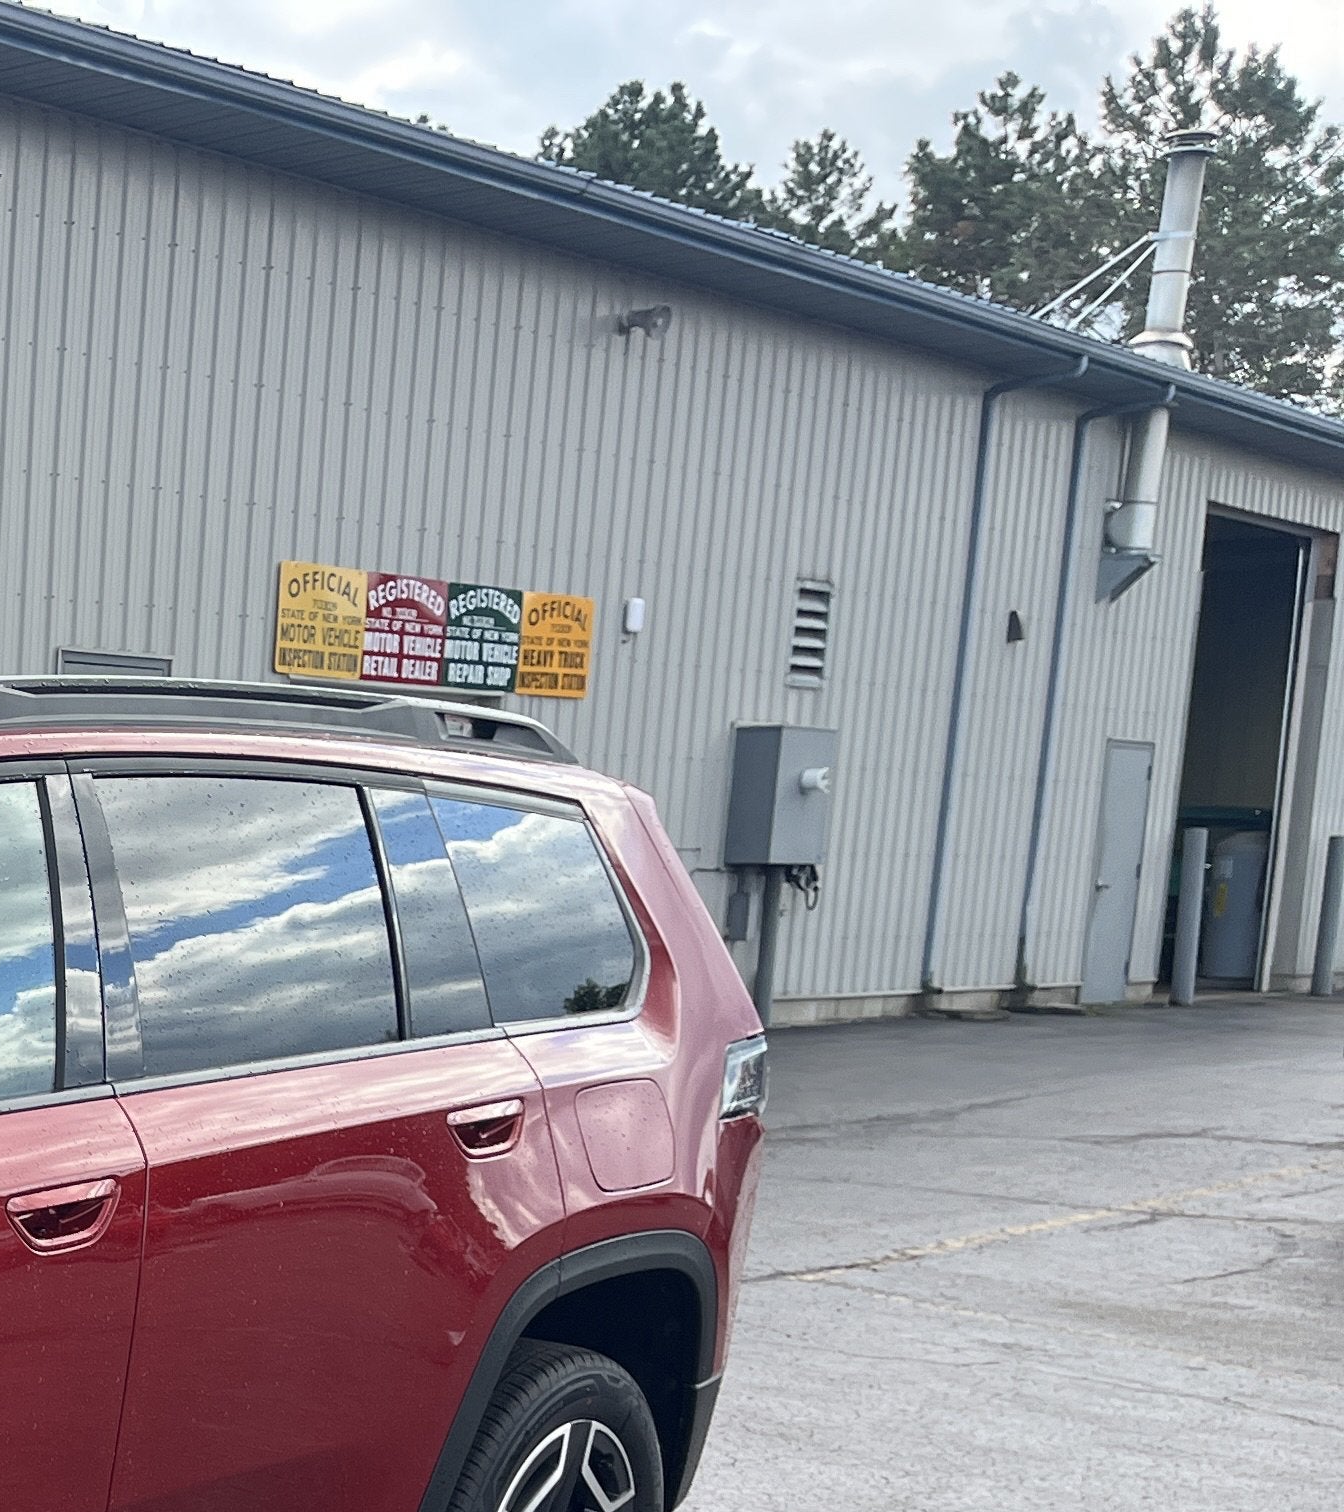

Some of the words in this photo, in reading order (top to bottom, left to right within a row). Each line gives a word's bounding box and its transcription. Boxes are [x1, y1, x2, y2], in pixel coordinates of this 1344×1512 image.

[288, 571, 359, 607] OFFICIAL
[368, 578, 445, 616] REGISTERED
[281, 609, 305, 620] STATE
[308, 611, 319, 621] OF
[449, 588, 521, 624] REGISTERED
[528, 600, 588, 632] OFFICIAL
[281, 624, 316, 644] MOTOR
[322, 627, 361, 649] VEHICLE
[365, 617, 390, 631] STATE
[391, 620, 403, 631] OF
[364, 631, 400, 654] MOTOR
[403, 635, 442, 658] VEHICLE
[482, 642, 518, 665] VEHICLE
[279, 648, 325, 670] INSPECTION
[328, 652, 359, 672] STATION
[362, 655, 399, 677] RETAIL
[401, 658, 439, 681] DEALER
[523, 649, 554, 667] HEAVY
[558, 650, 585, 669] TRUCK
[448, 663, 485, 684] REPAIR
[486, 666, 511, 686] SHOP
